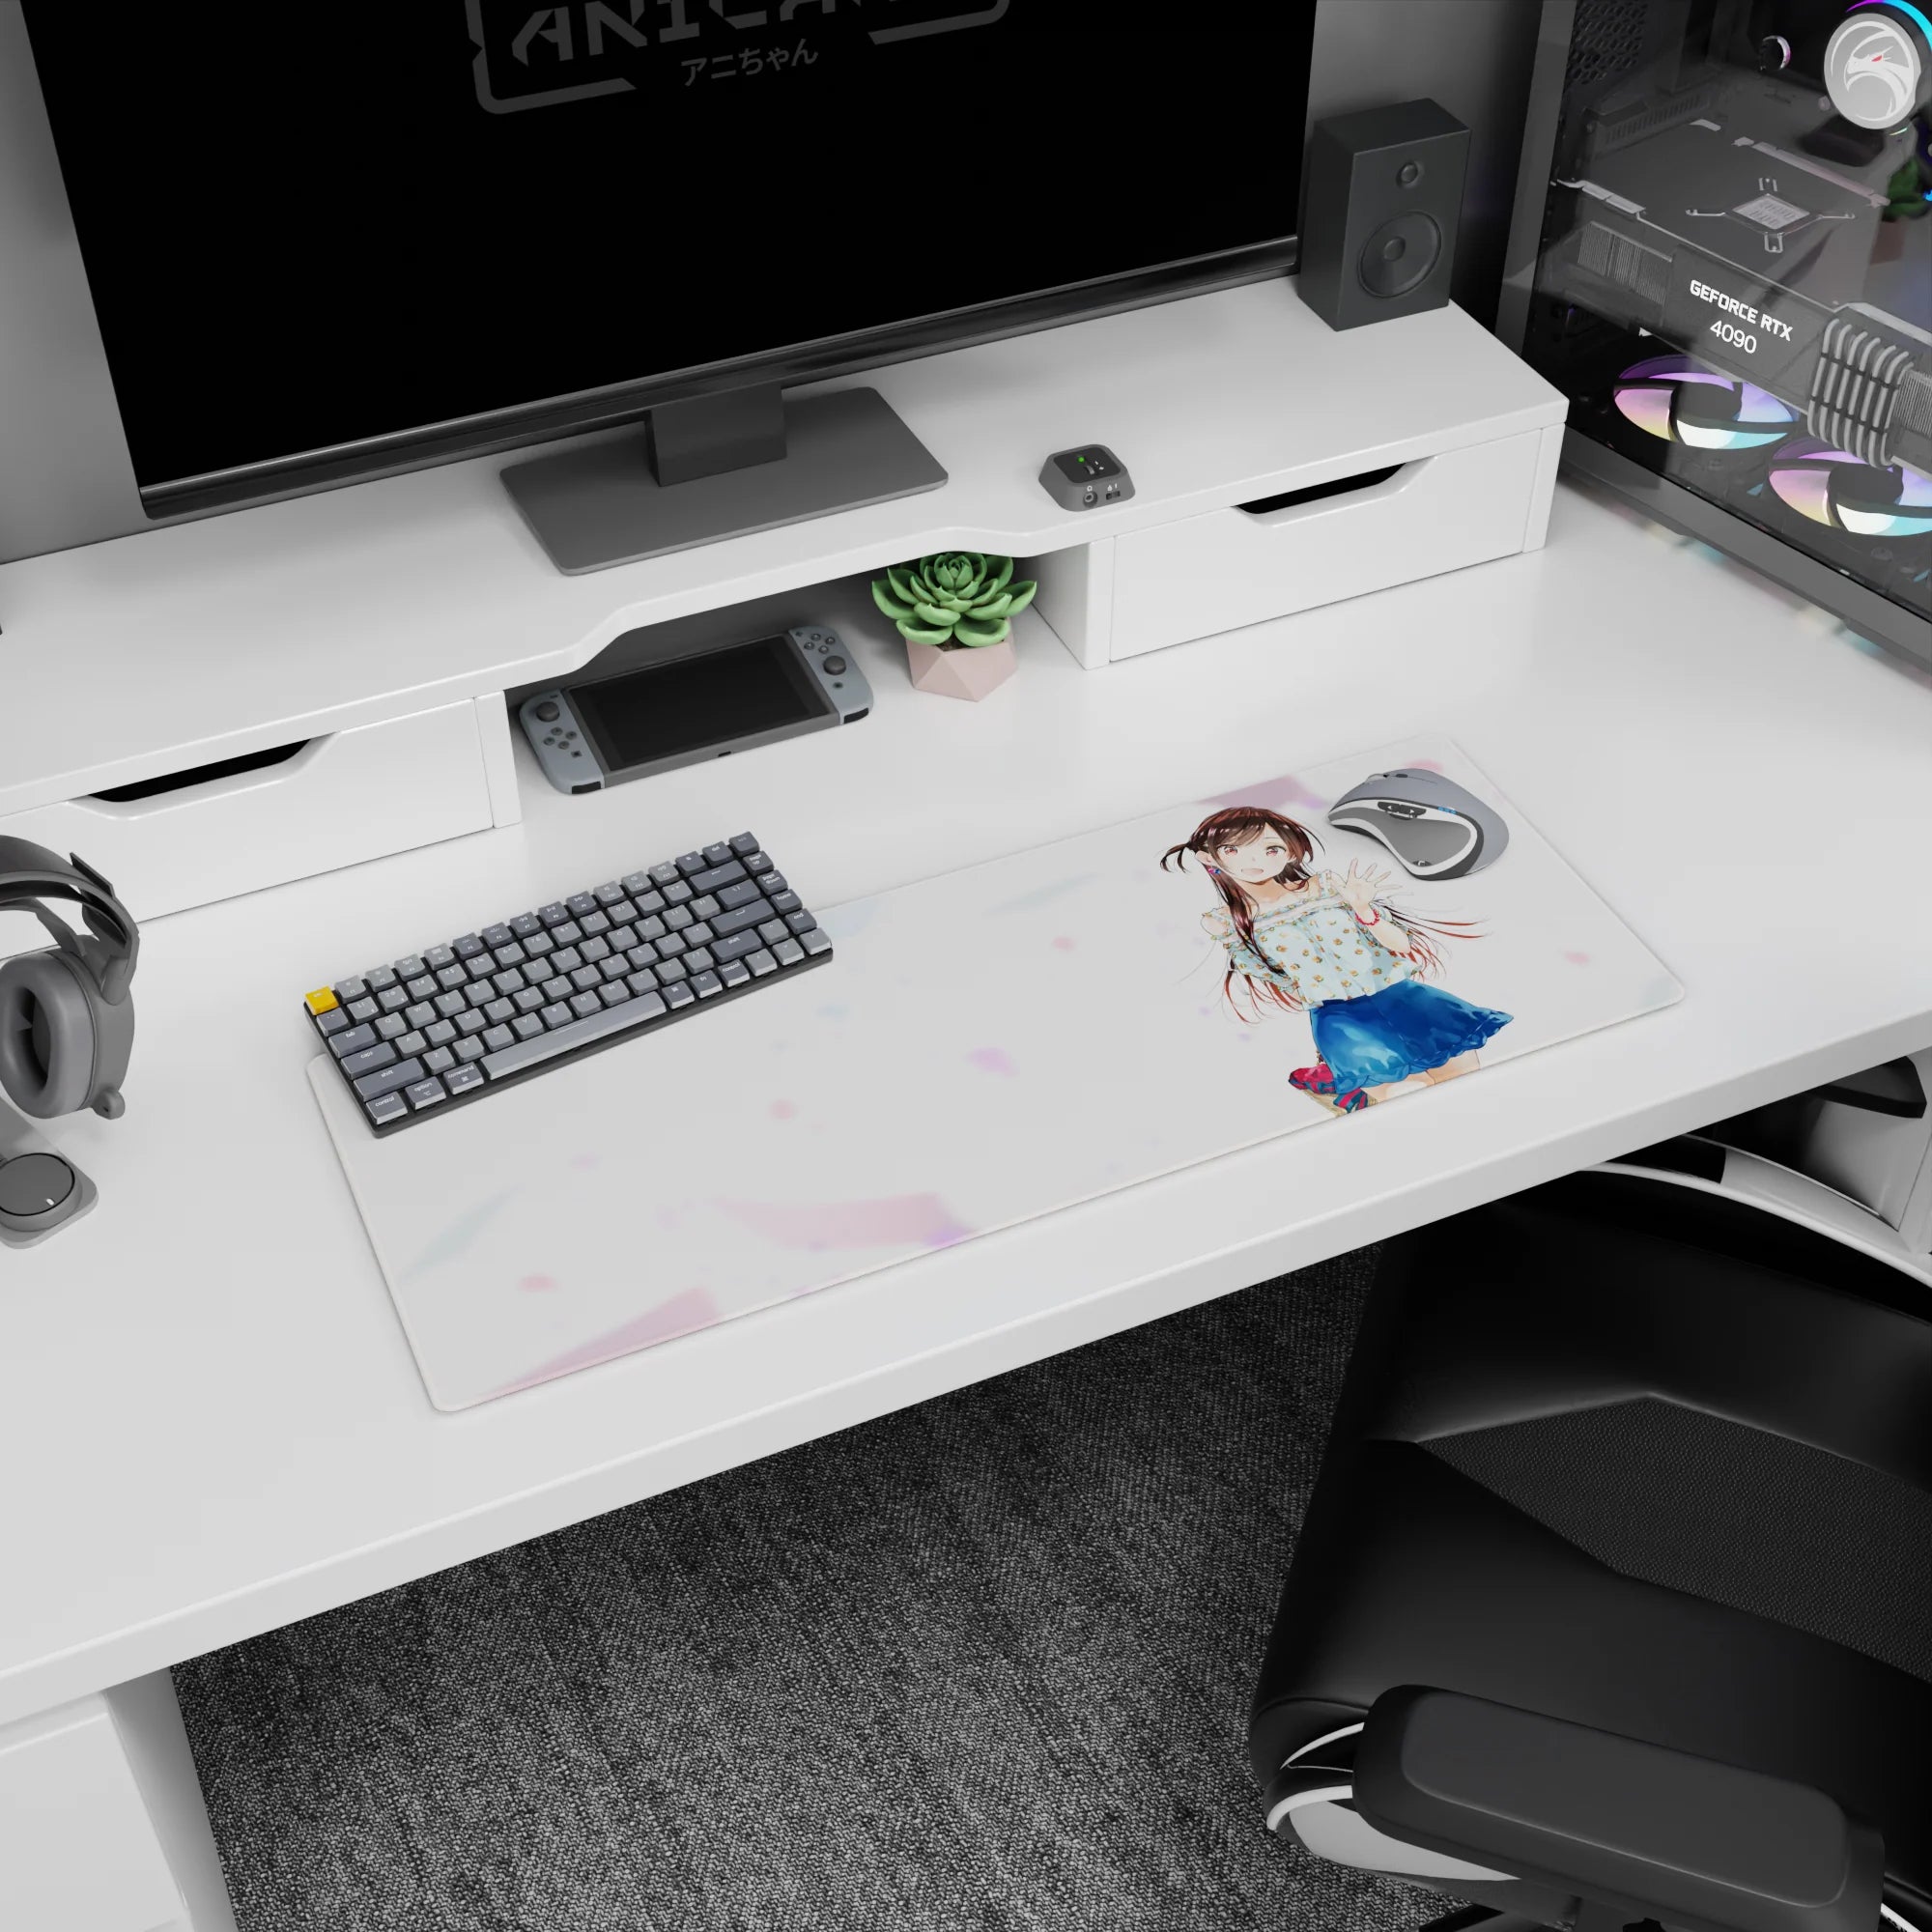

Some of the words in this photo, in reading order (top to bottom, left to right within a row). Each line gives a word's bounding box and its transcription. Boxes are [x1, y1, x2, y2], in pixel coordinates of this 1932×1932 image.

[681, 38, 819, 87] アニちゃん
[1690, 279, 1759, 324] GEFORCE
[1760, 313, 1793, 341] RTX
[1710, 320, 1757, 354] 4090
[447, 1065, 475, 1079] command
[413, 1082, 433, 1093] option
[375, 1095, 395, 1107] control
